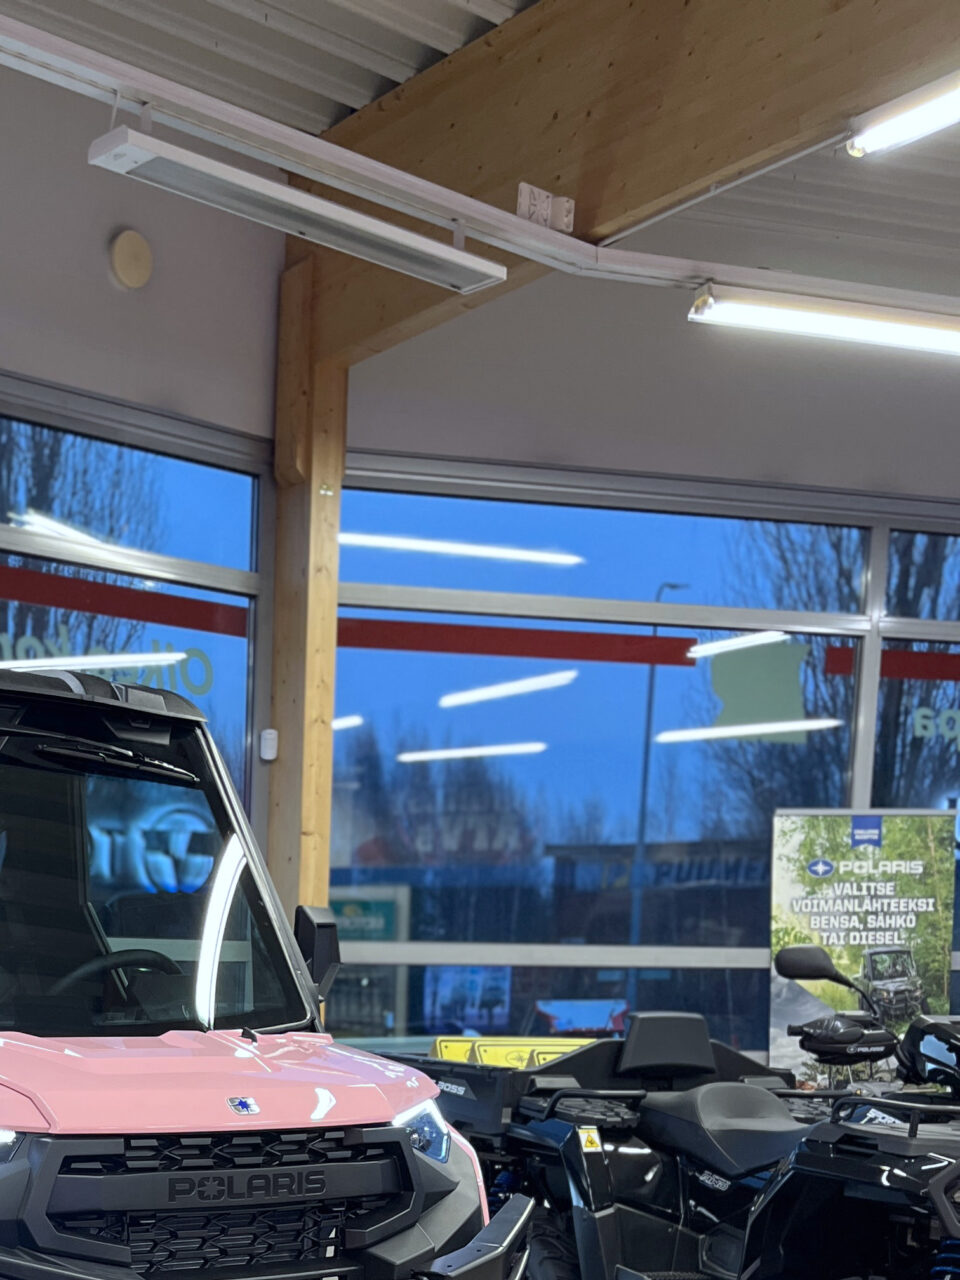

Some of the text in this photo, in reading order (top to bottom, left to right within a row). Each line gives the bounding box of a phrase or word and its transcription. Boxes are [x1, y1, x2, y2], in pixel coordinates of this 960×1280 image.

[839, 860, 923, 874] POLARIS
[834, 882, 895, 895] VALITSE
[793, 897, 935, 912] VOIMANLÄHTEEKSI
[810, 913, 916, 930] BENSA, SÄHKÖ
[821, 931, 905, 944] TAI DIESEL.
[168, 1171, 326, 1202] POLARIS
